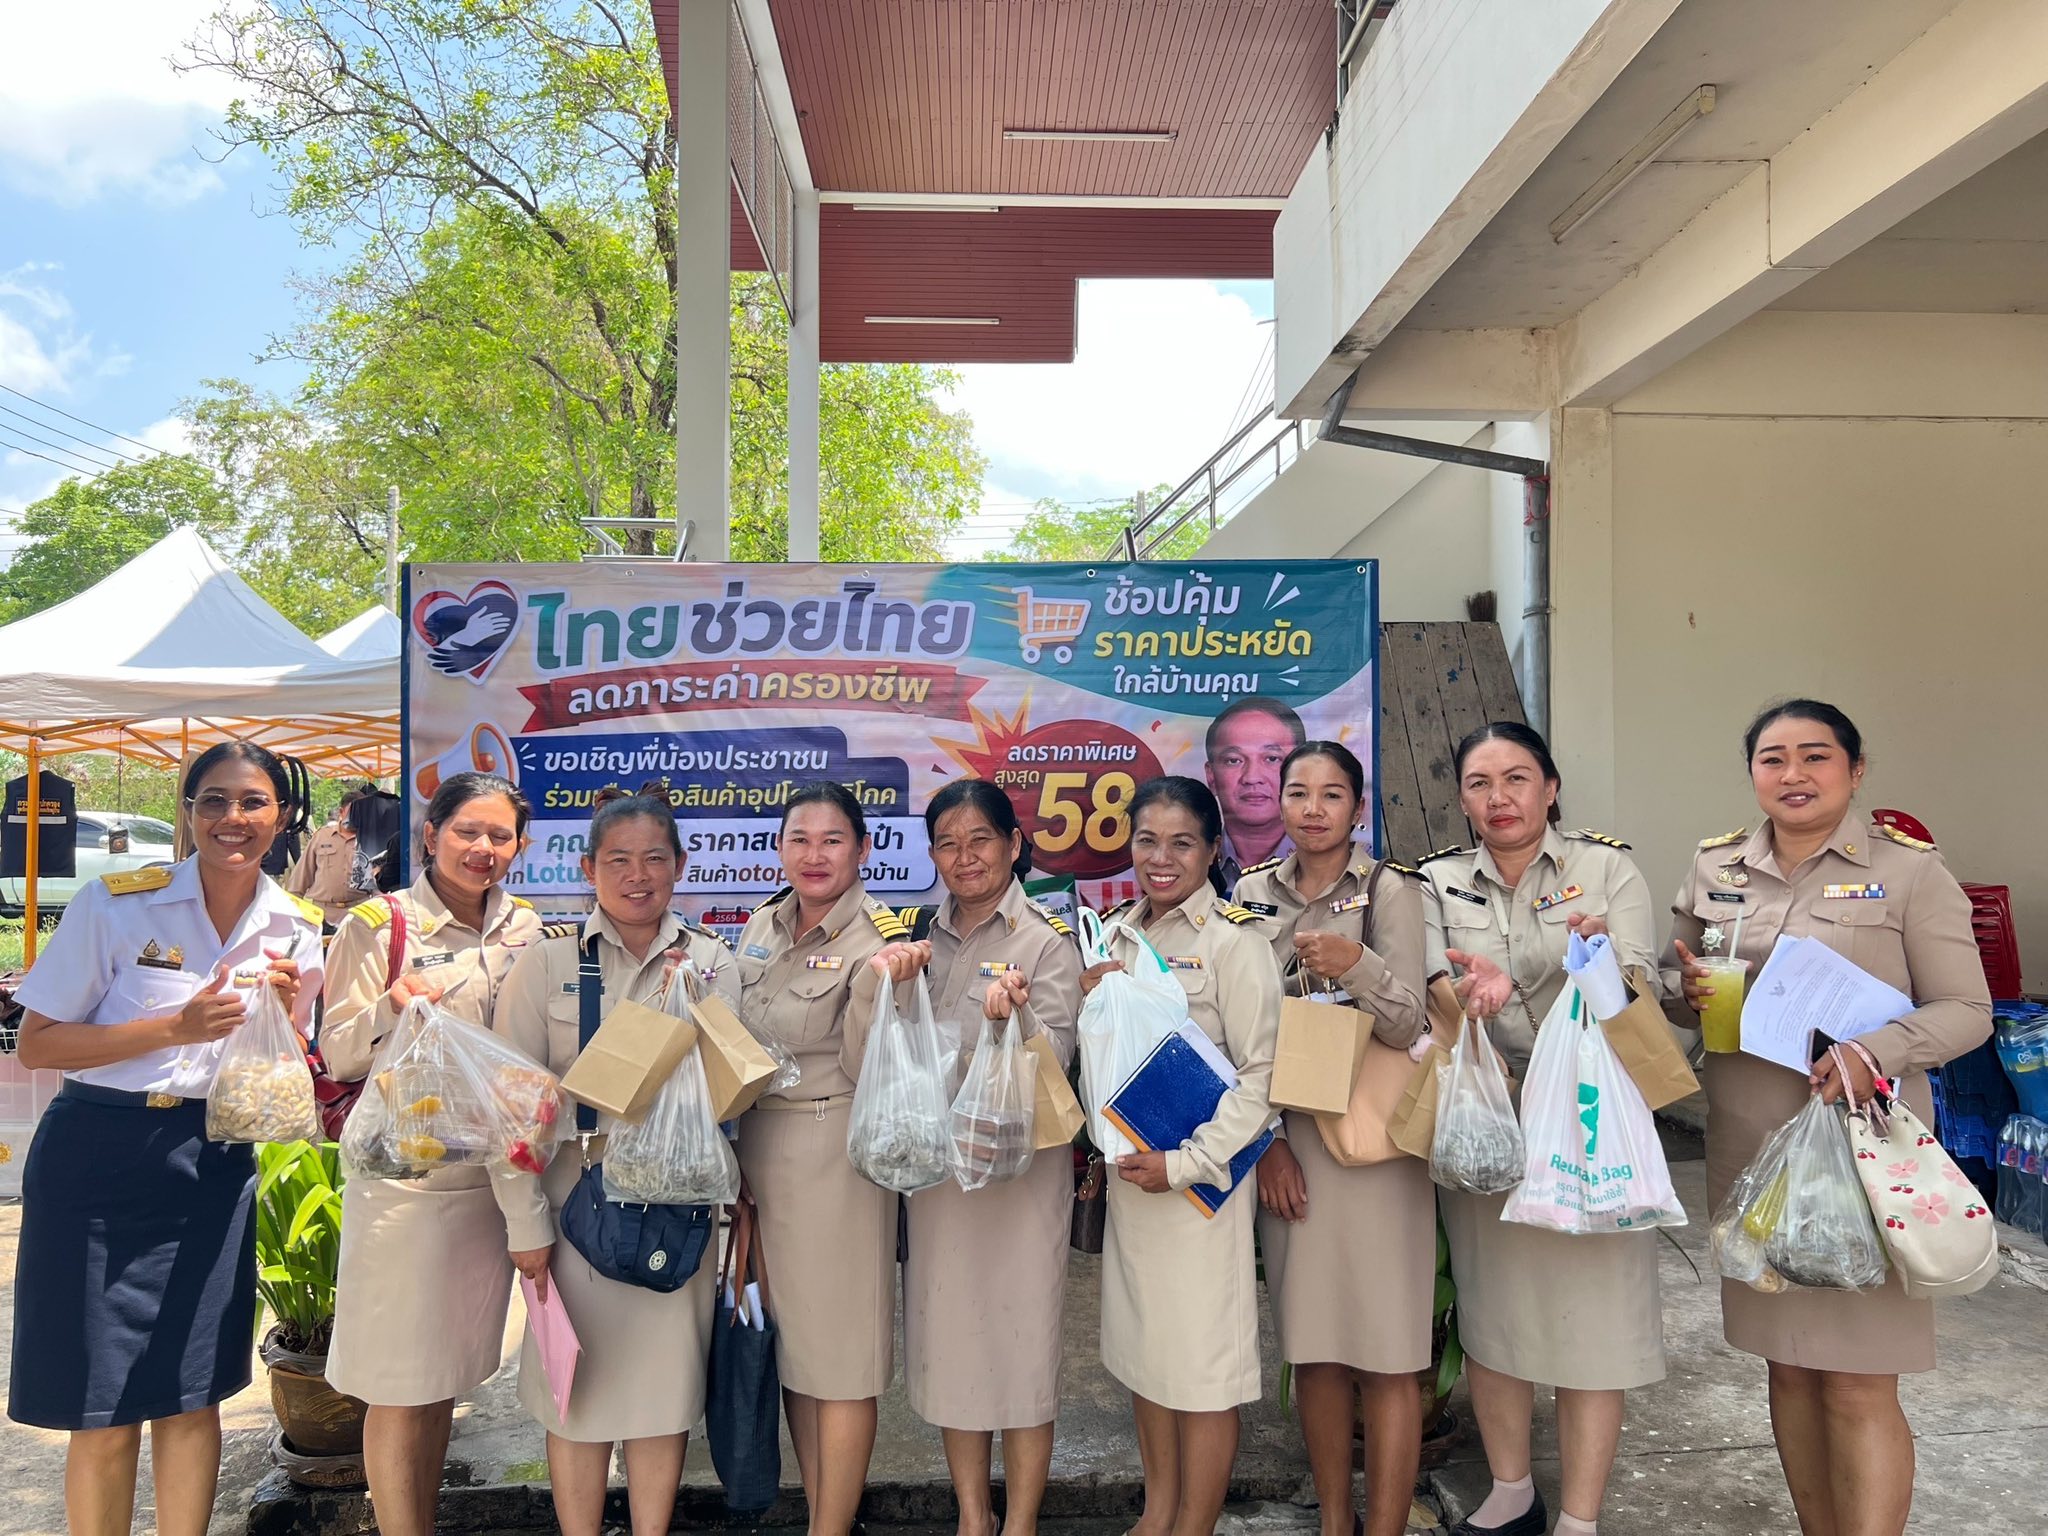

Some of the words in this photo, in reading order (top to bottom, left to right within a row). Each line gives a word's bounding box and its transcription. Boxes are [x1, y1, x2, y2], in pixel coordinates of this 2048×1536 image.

[1103, 572, 1241, 626] ช้อปคุ้ม
[1093, 619, 1312, 658] ราคาประหยัด
[567, 663, 932, 714] ลดภาระค่าครองชีพ
[1113, 664, 1258, 702] ใกล้บ้านคุณ
[544, 737, 828, 775] ขอเชิญพี่น้องประชาชน
[1007, 741, 1137, 762] ลดราคาพิเศษ
[994, 769, 1040, 790] สูงสุด
[1033, 771, 1137, 853] 58
[715, 914, 737, 923] 2569
